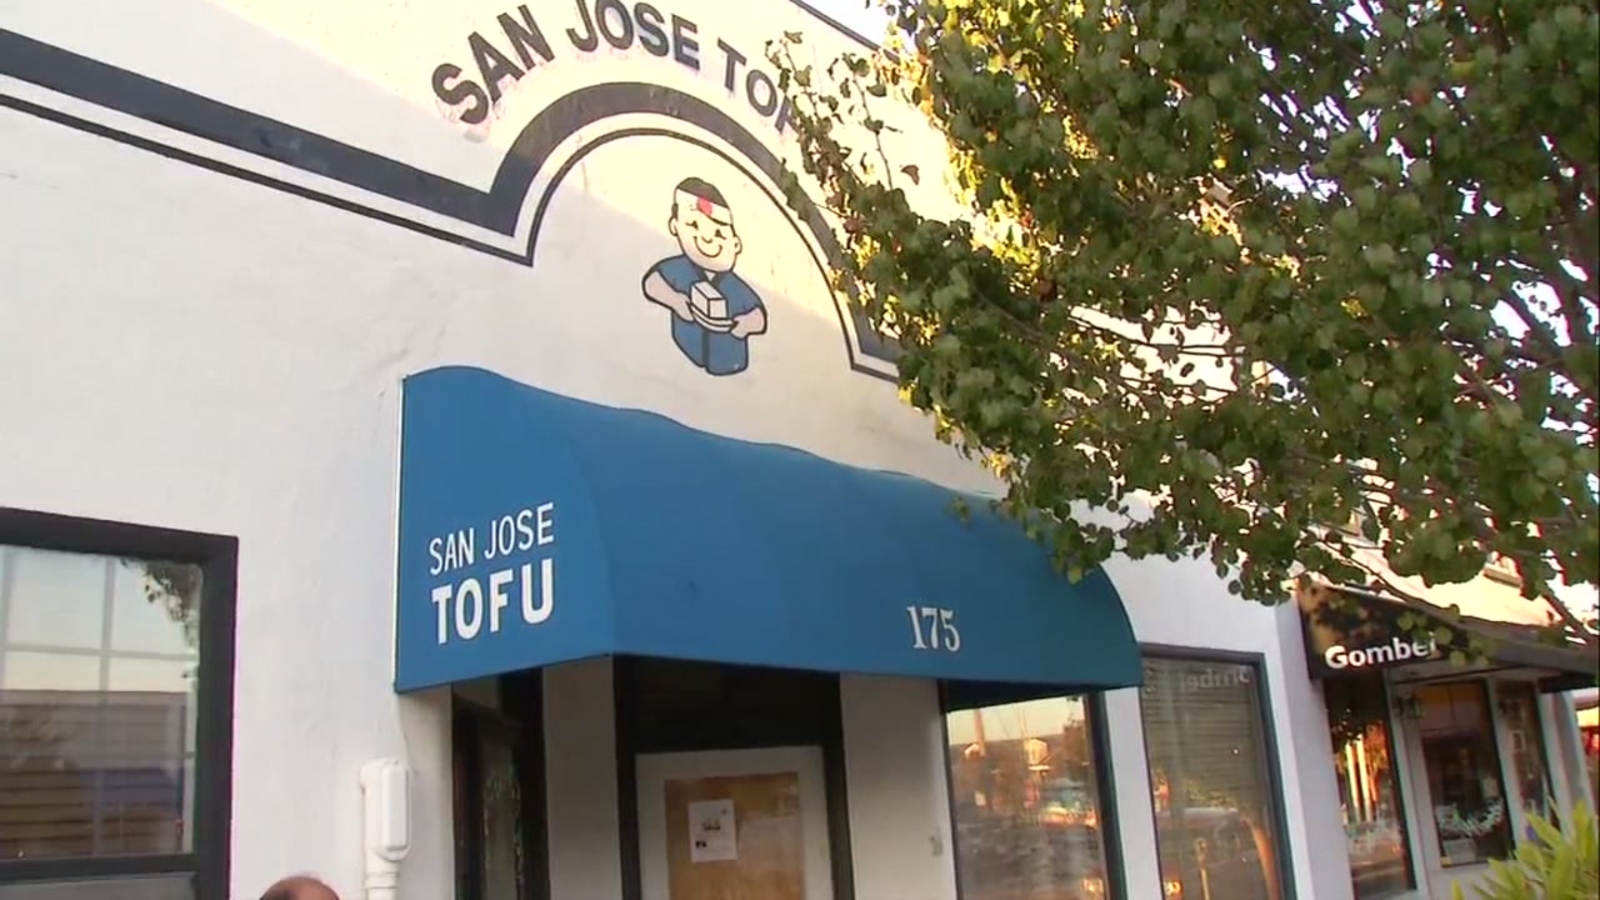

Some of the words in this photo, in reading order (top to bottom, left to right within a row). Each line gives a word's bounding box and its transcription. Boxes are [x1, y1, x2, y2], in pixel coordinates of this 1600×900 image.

[432, 4, 555, 124] SAN
[565, 0, 700, 71] JOSE
[429, 527, 475, 576] SAN
[484, 502, 555, 560] JOSE
[431, 557, 554, 646] TOFU
[906, 605, 960, 652] 175
